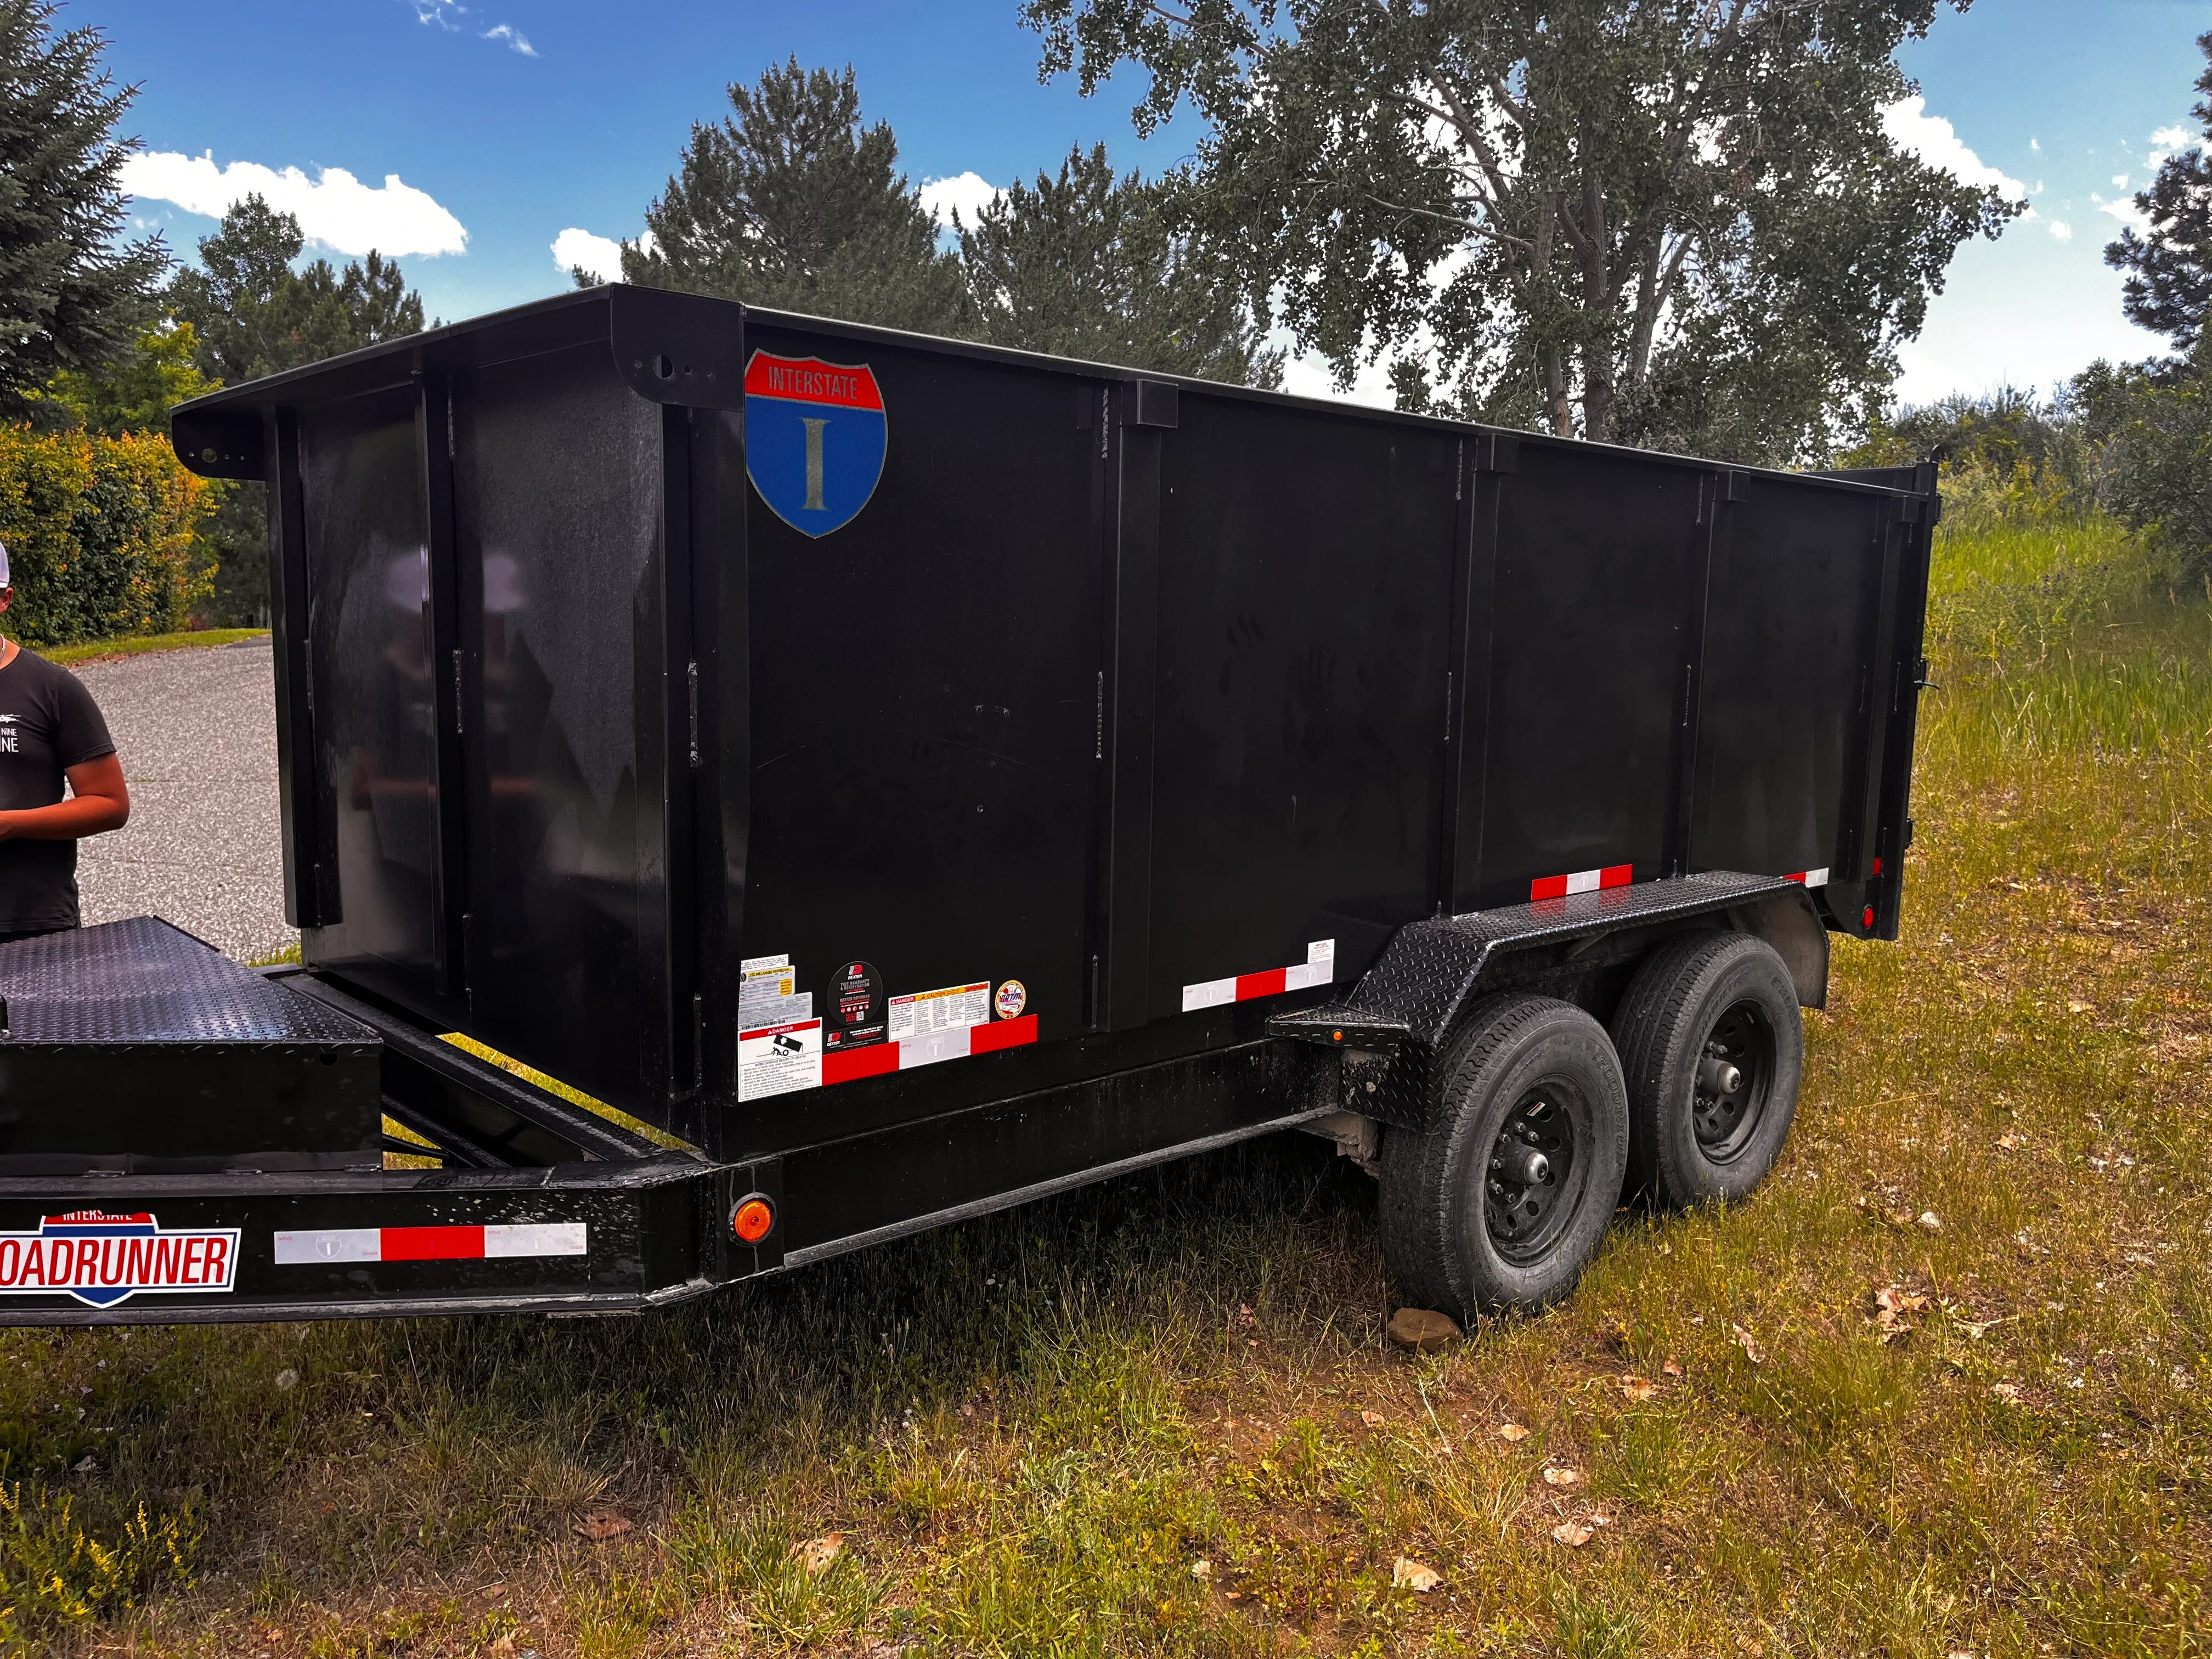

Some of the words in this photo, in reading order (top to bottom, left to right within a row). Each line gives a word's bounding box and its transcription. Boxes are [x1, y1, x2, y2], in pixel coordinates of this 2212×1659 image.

[768, 366, 858, 400] INTERSTATE
[1, 727, 18, 736] NINE
[0, 737, 19, 753] NE
[772, 1026, 794, 1035] DANGER
